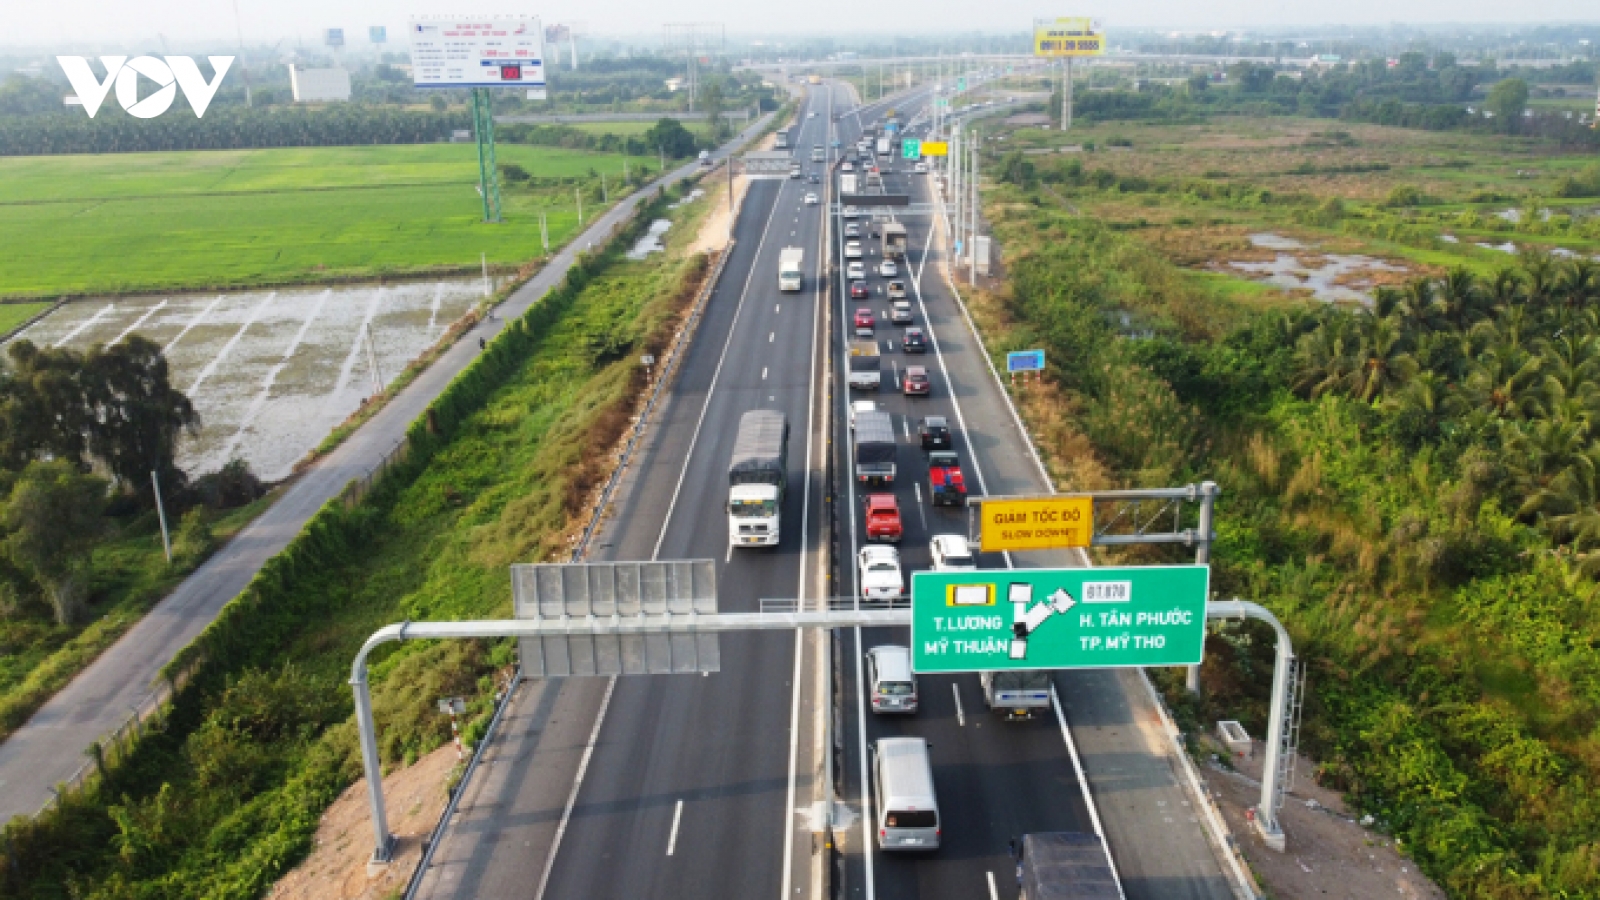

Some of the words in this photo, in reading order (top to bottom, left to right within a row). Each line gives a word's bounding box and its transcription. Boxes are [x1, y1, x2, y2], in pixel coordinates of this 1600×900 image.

[993, 509, 1027, 525] GIẢM
[1032, 507, 1058, 523] TỐC
[1002, 529, 1032, 540] SLOW
[1035, 527, 1069, 538] DOWN
[1080, 613, 1095, 628] H.
[924, 636, 949, 656] MỸ
[953, 636, 1008, 657] THUẬN
[1133, 634, 1166, 649] THO
